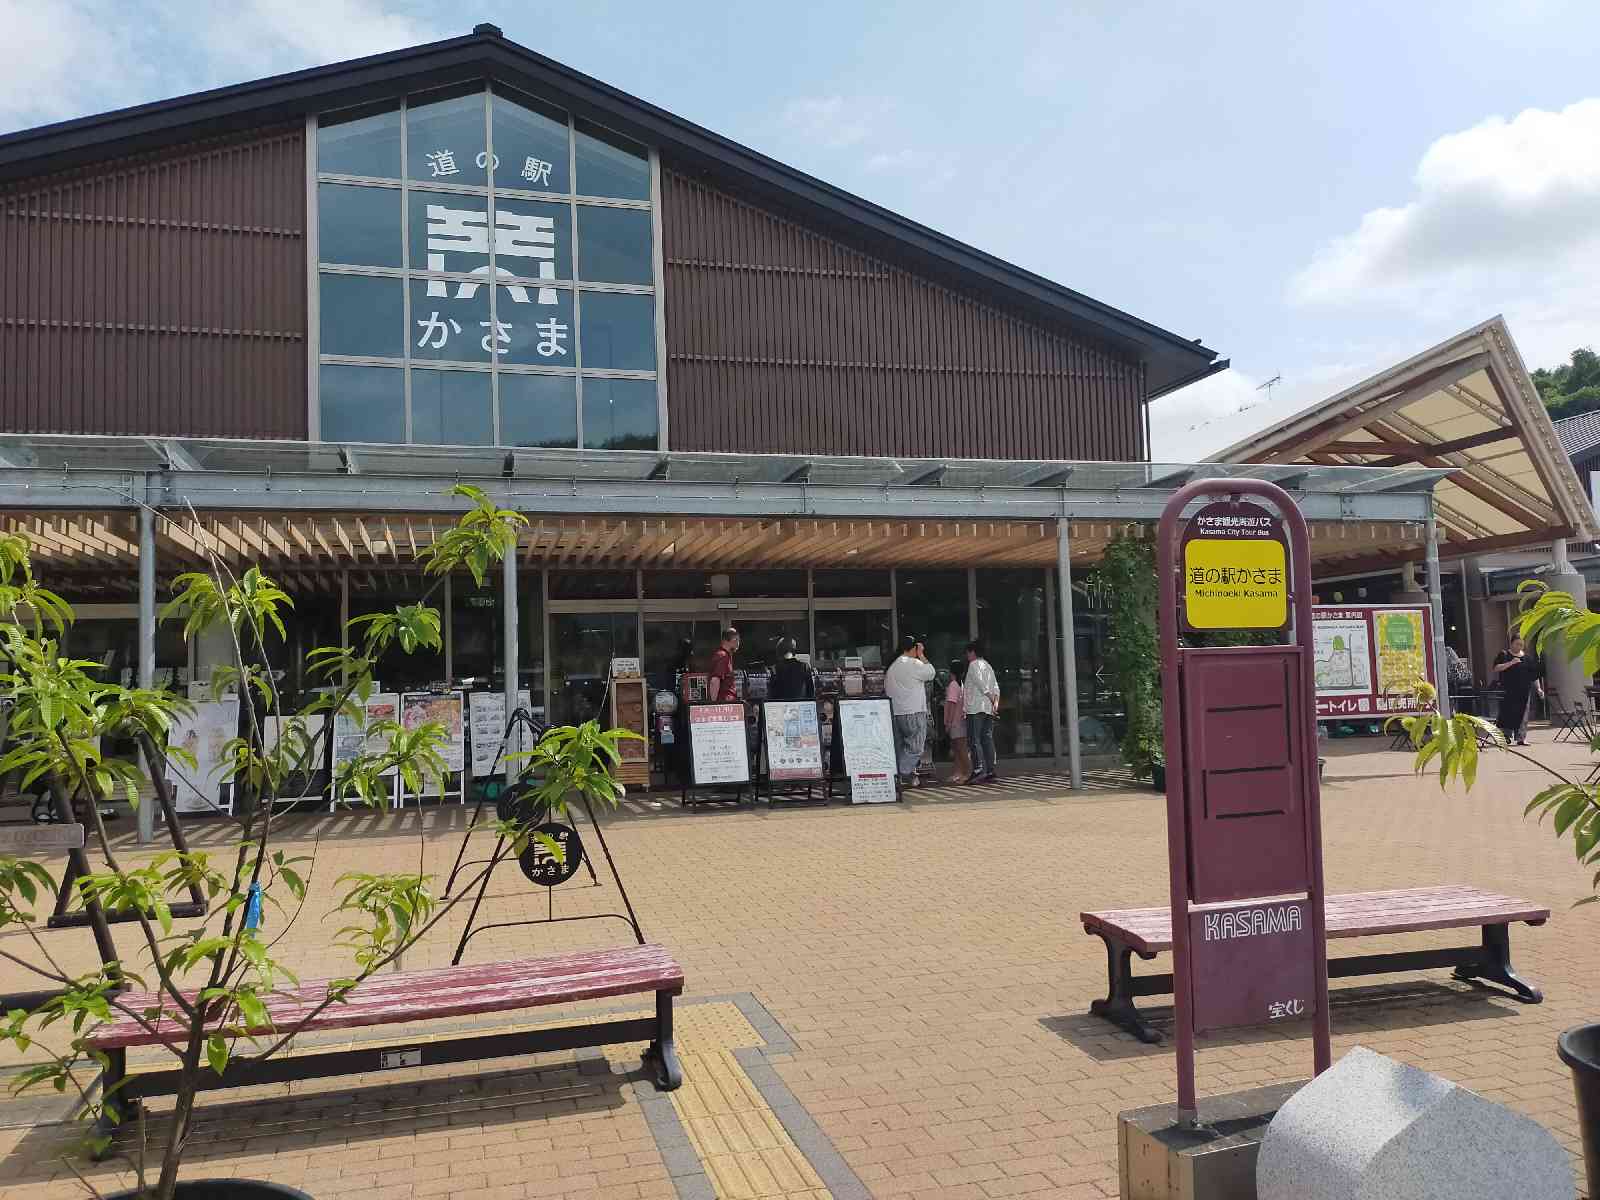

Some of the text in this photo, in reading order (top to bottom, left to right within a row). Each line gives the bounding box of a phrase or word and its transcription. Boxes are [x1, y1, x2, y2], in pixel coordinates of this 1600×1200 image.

[425, 149, 553, 187] 道の駅
[417, 311, 569, 357] かさま
[1227, 528, 1240, 536] City
[1189, 567, 1282, 585] 道の駅かさま
[1194, 589, 1279, 598] Michinoeki Kasama
[1328, 699, 1357, 713] トイレ
[1204, 905, 1302, 941] KASAMA
[1268, 999, 1305, 1019] 宝くじ
